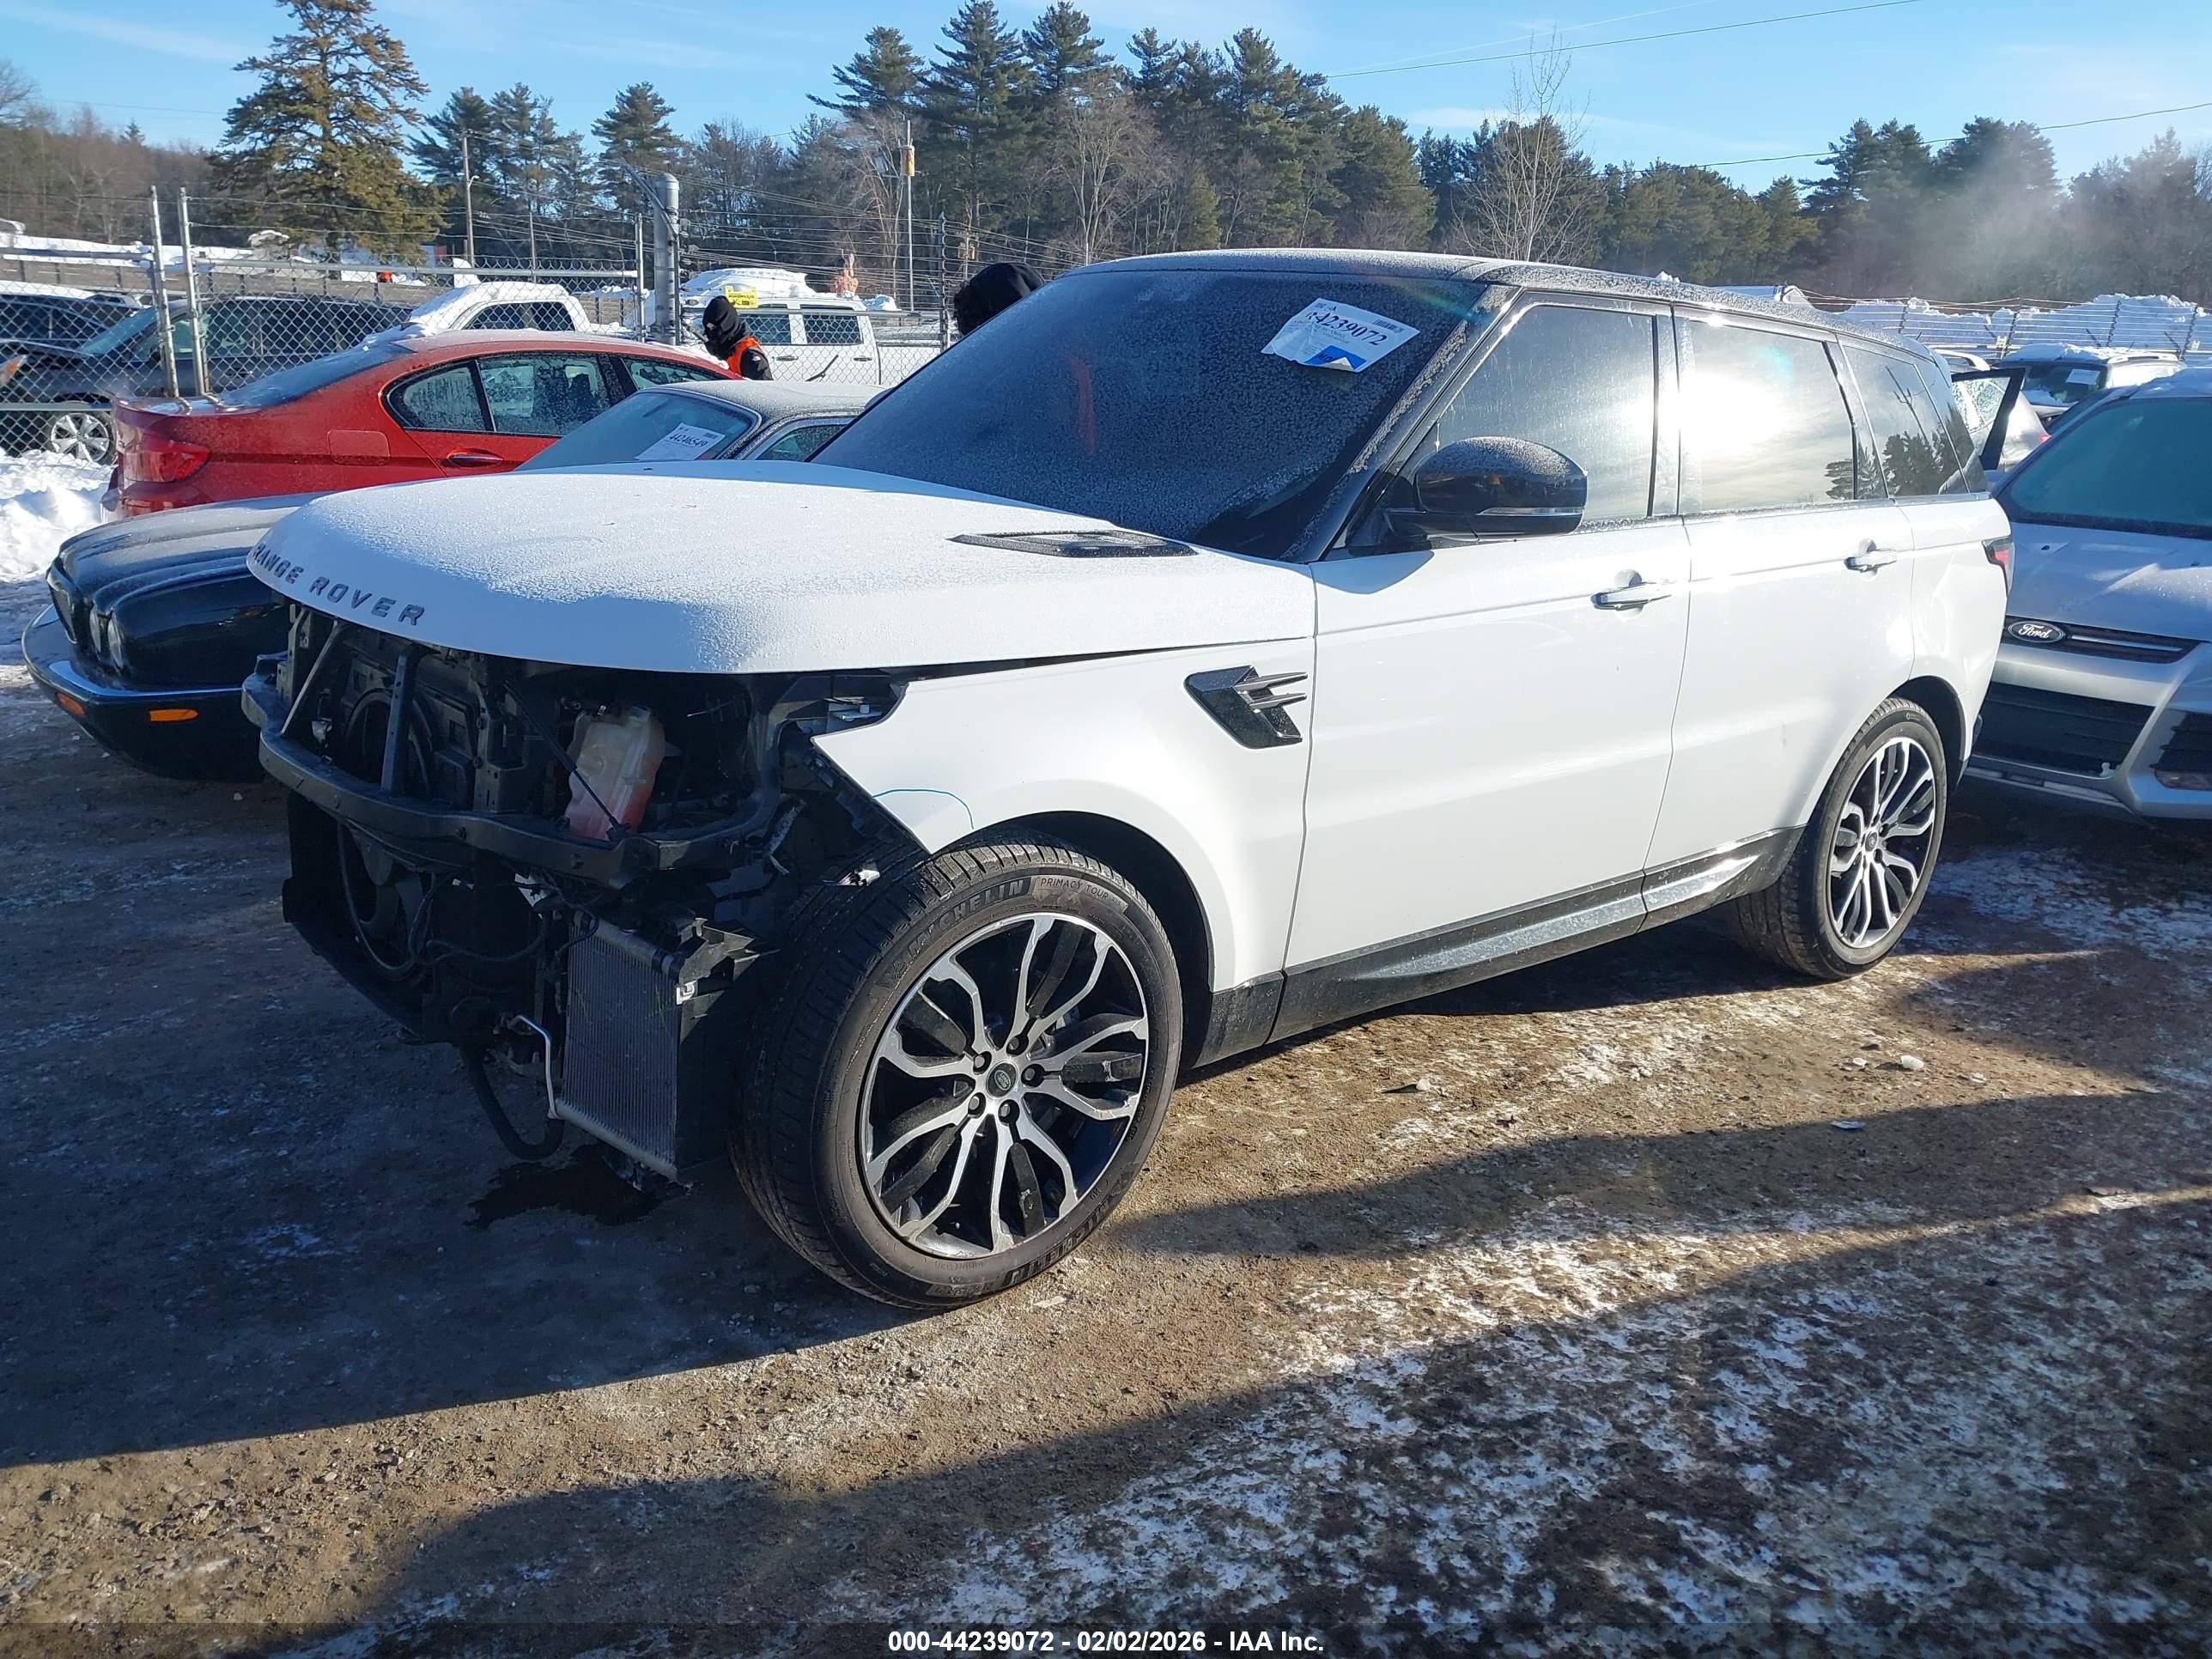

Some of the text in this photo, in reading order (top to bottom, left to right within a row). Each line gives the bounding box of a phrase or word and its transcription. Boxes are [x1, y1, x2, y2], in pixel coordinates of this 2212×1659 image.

[252, 543, 425, 626] RANGE ROVER
[2018, 623, 2053, 639] Ford
[907, 878, 1024, 957] MICHELIN
[1040, 877, 1083, 890] PRIMACY
[1085, 884, 1109, 901] TOUR
